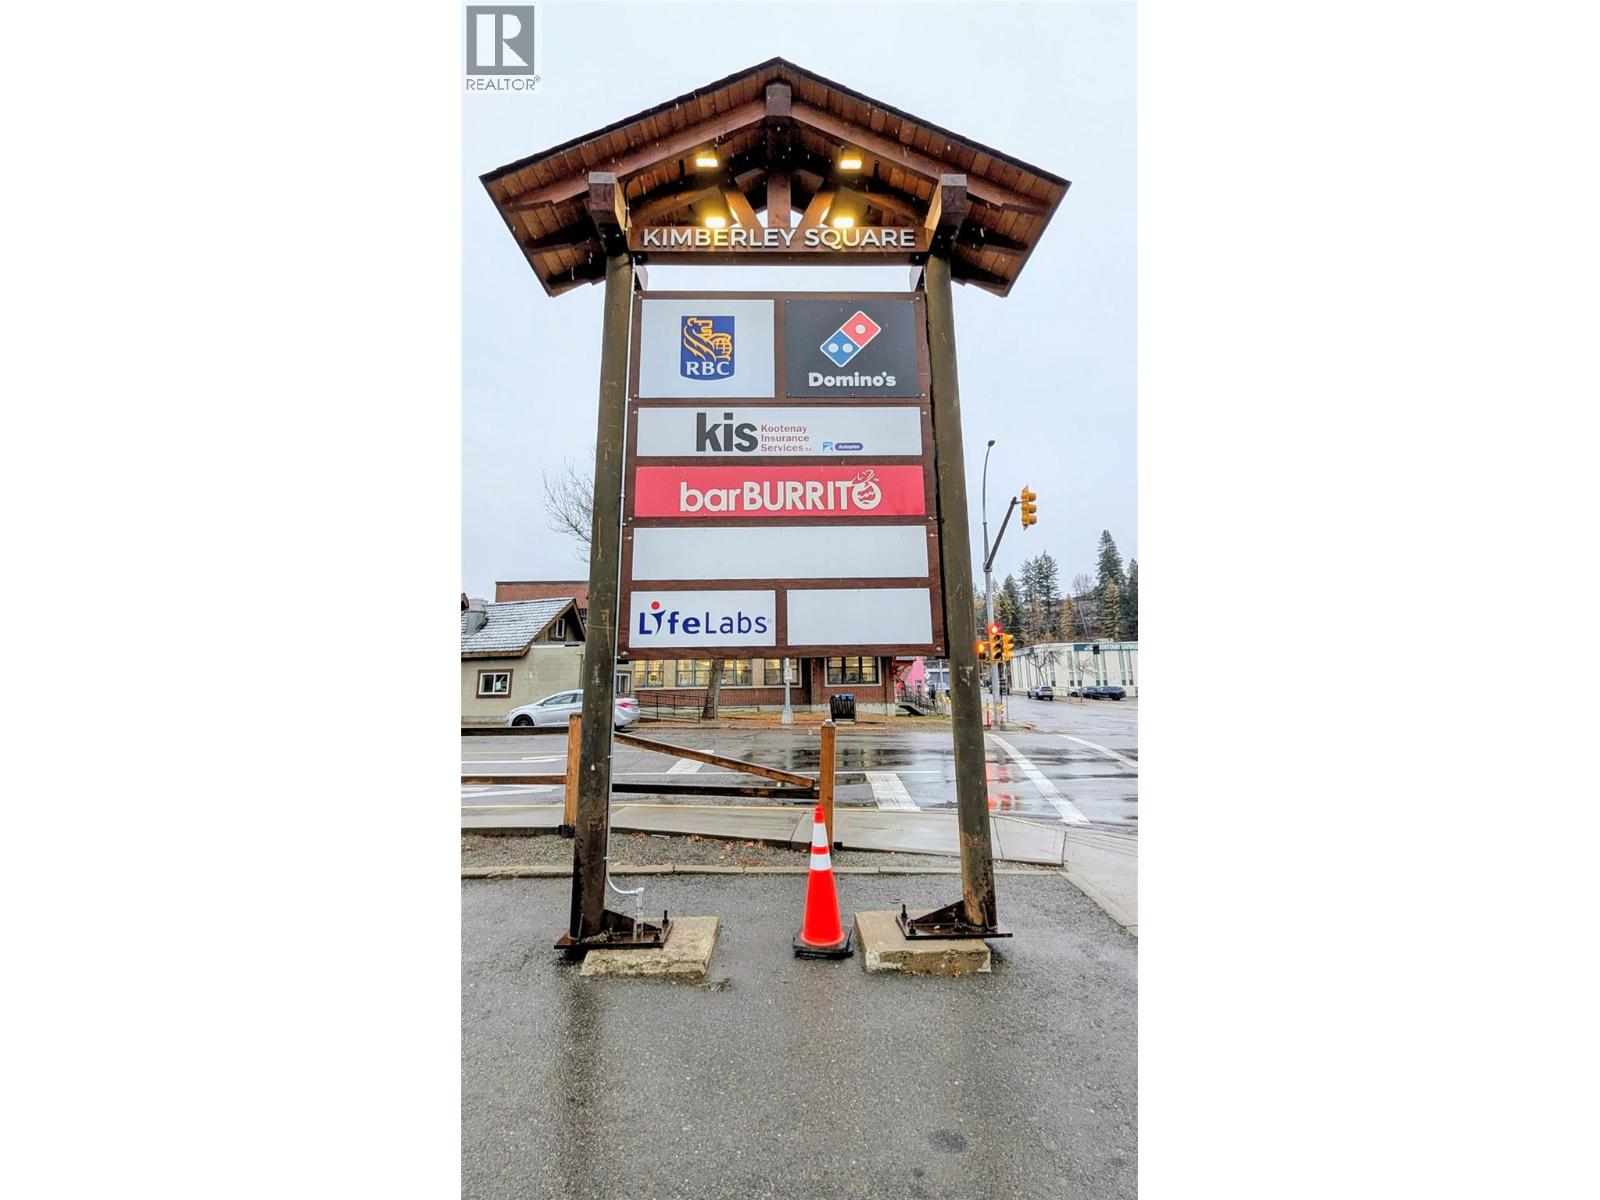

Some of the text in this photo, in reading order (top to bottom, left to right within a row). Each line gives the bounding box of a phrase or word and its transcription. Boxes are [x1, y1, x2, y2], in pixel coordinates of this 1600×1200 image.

[642, 228, 916, 250] KIMBERLEY SQUARE
[685, 361, 730, 376] RBC
[808, 371, 897, 388] Domino's
[696, 412, 759, 452] kis
[760, 424, 808, 434] Kootenay
[761, 434, 810, 443] Insurance
[760, 443, 804, 452] Services
[680, 478, 882, 512] barBURRITO
[638, 601, 768, 636] LifeLabs
